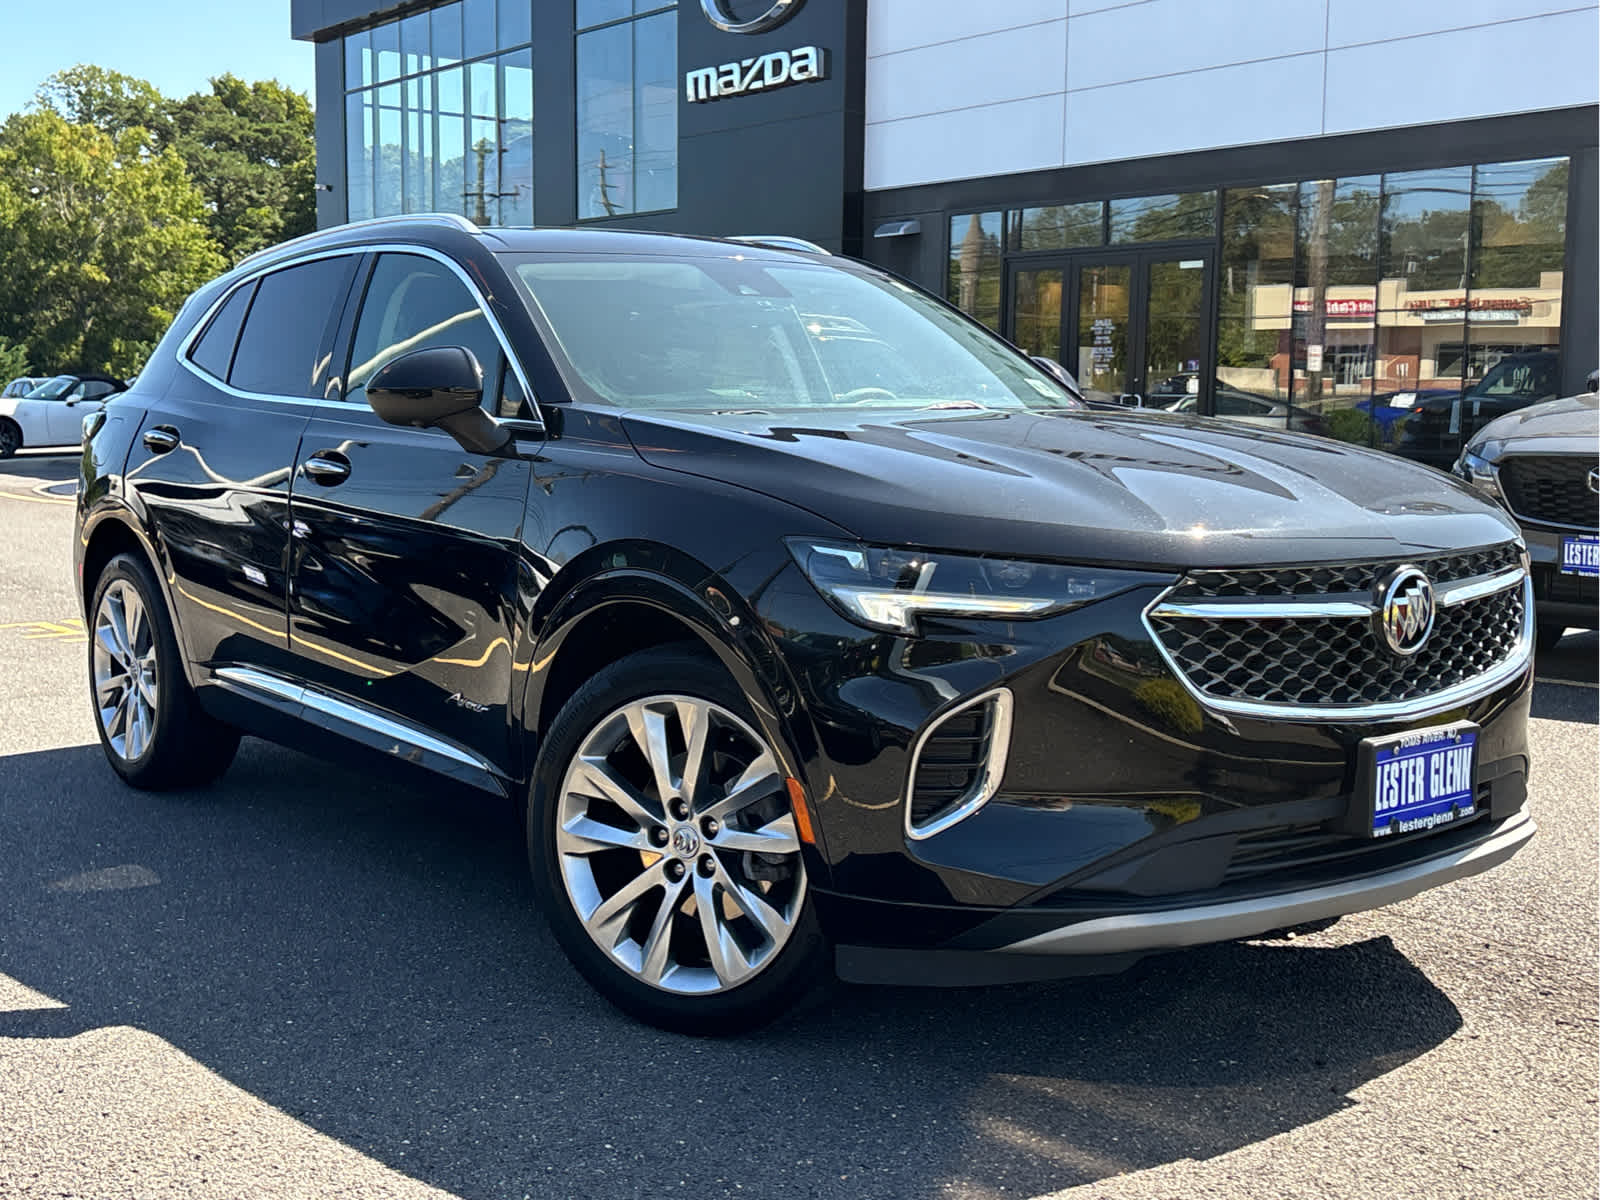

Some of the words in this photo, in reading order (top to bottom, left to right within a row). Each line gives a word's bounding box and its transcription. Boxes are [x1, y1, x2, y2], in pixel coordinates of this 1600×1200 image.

[1375, 757, 1424, 811] LESTER
[1430, 746, 1472, 798] GLENN
[1399, 812, 1454, 833] lesterglenn
